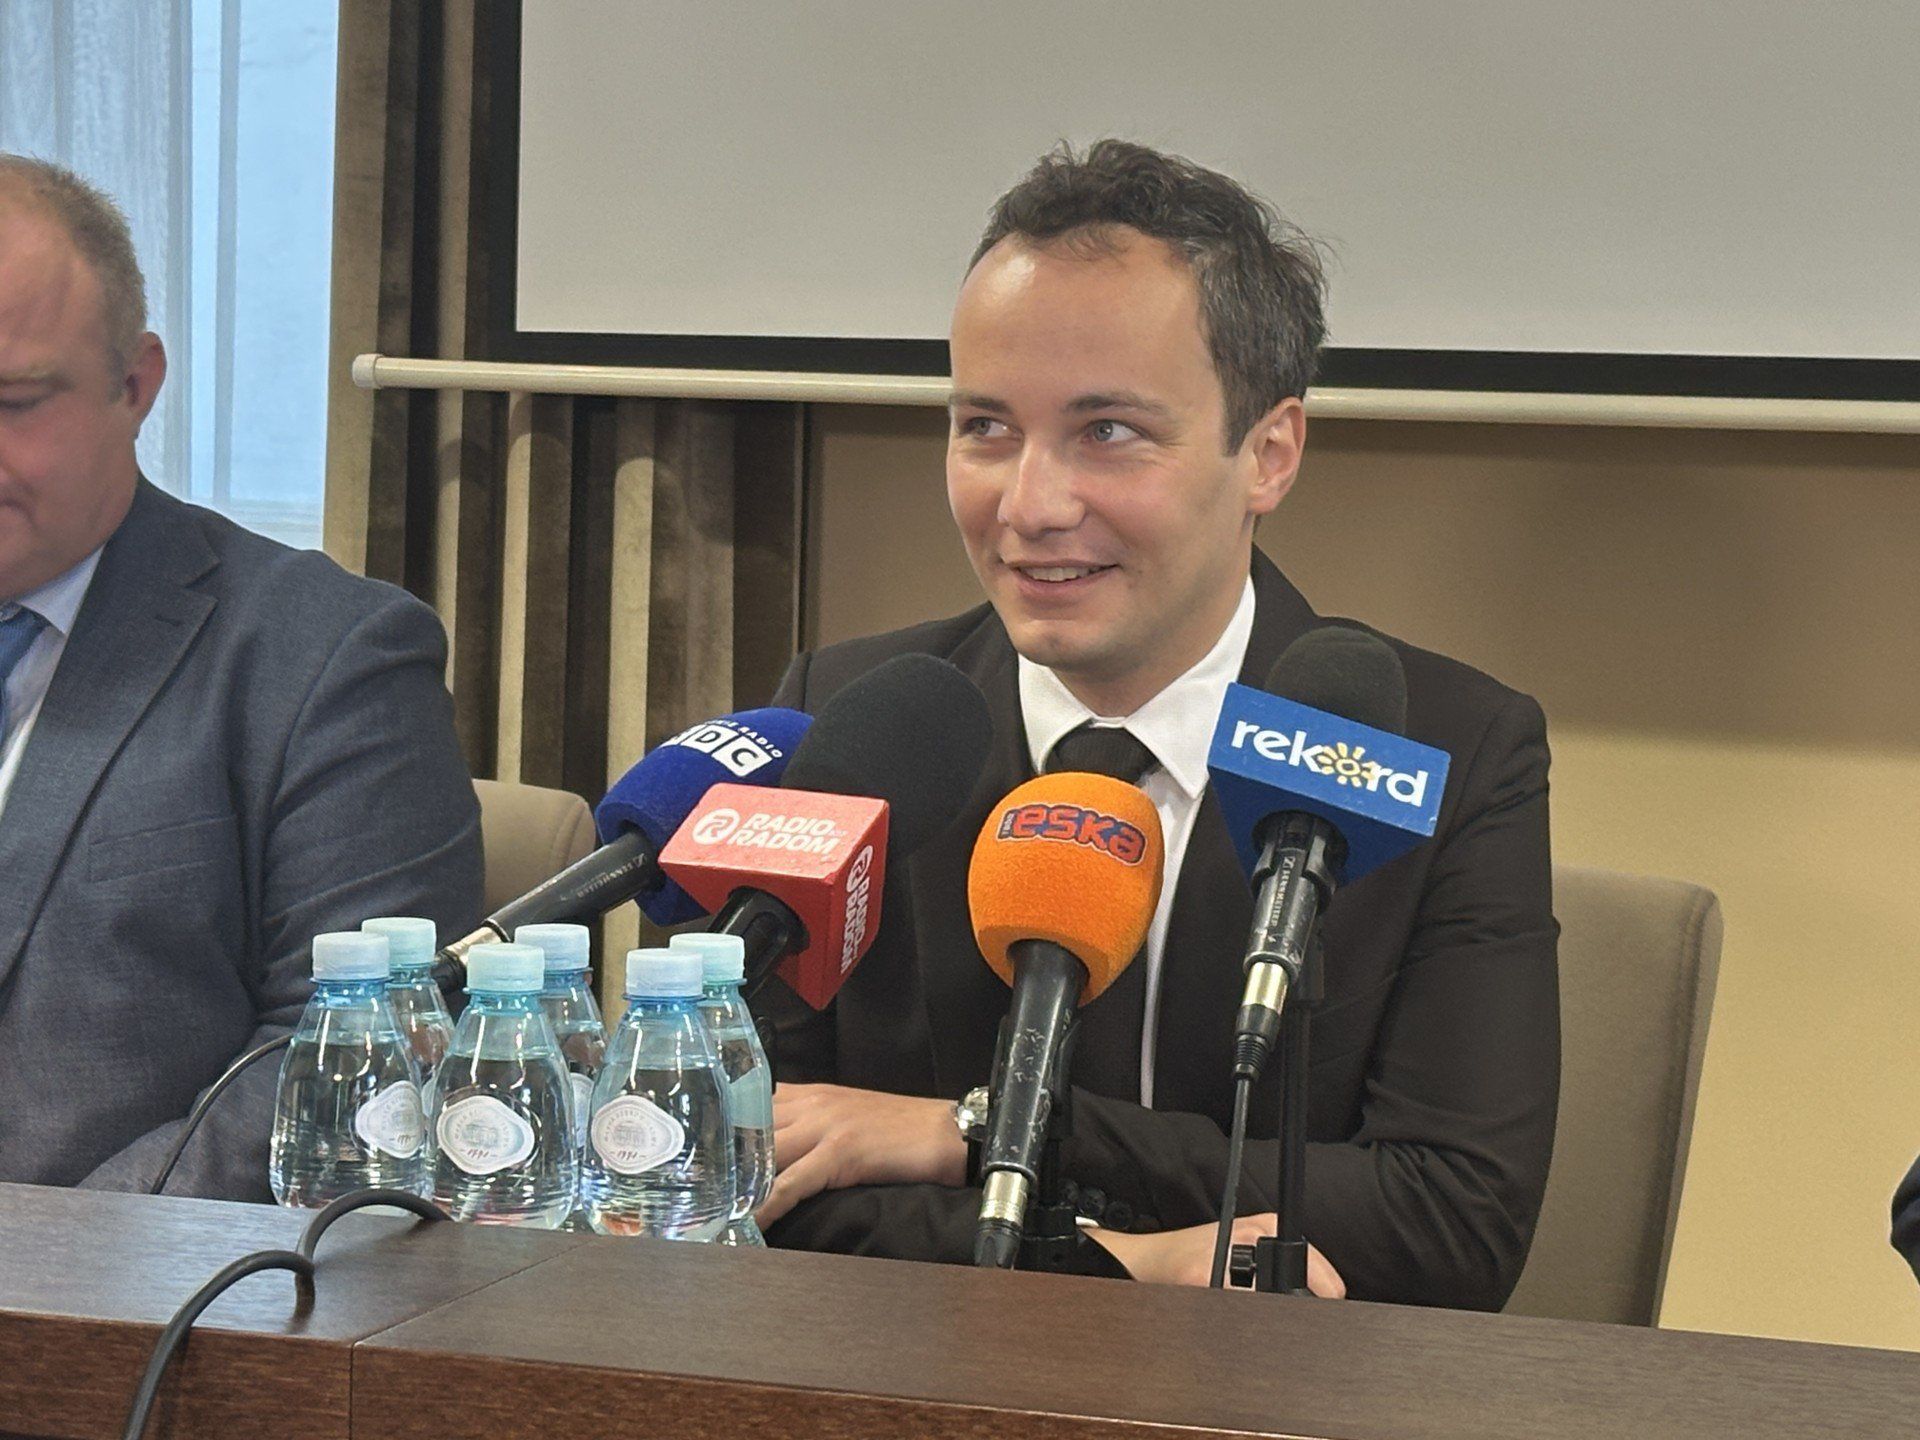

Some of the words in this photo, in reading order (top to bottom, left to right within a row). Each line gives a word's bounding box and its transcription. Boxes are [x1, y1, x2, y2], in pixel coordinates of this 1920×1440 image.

[668, 727, 763, 770] DC
[1230, 720, 1429, 808] rekord
[726, 828, 840, 854] RADOM
[742, 812, 836, 840] RADIO
[1011, 805, 1146, 863] eska
[840, 888, 858, 975] RADOM
[854, 876, 870, 946] RADIO
